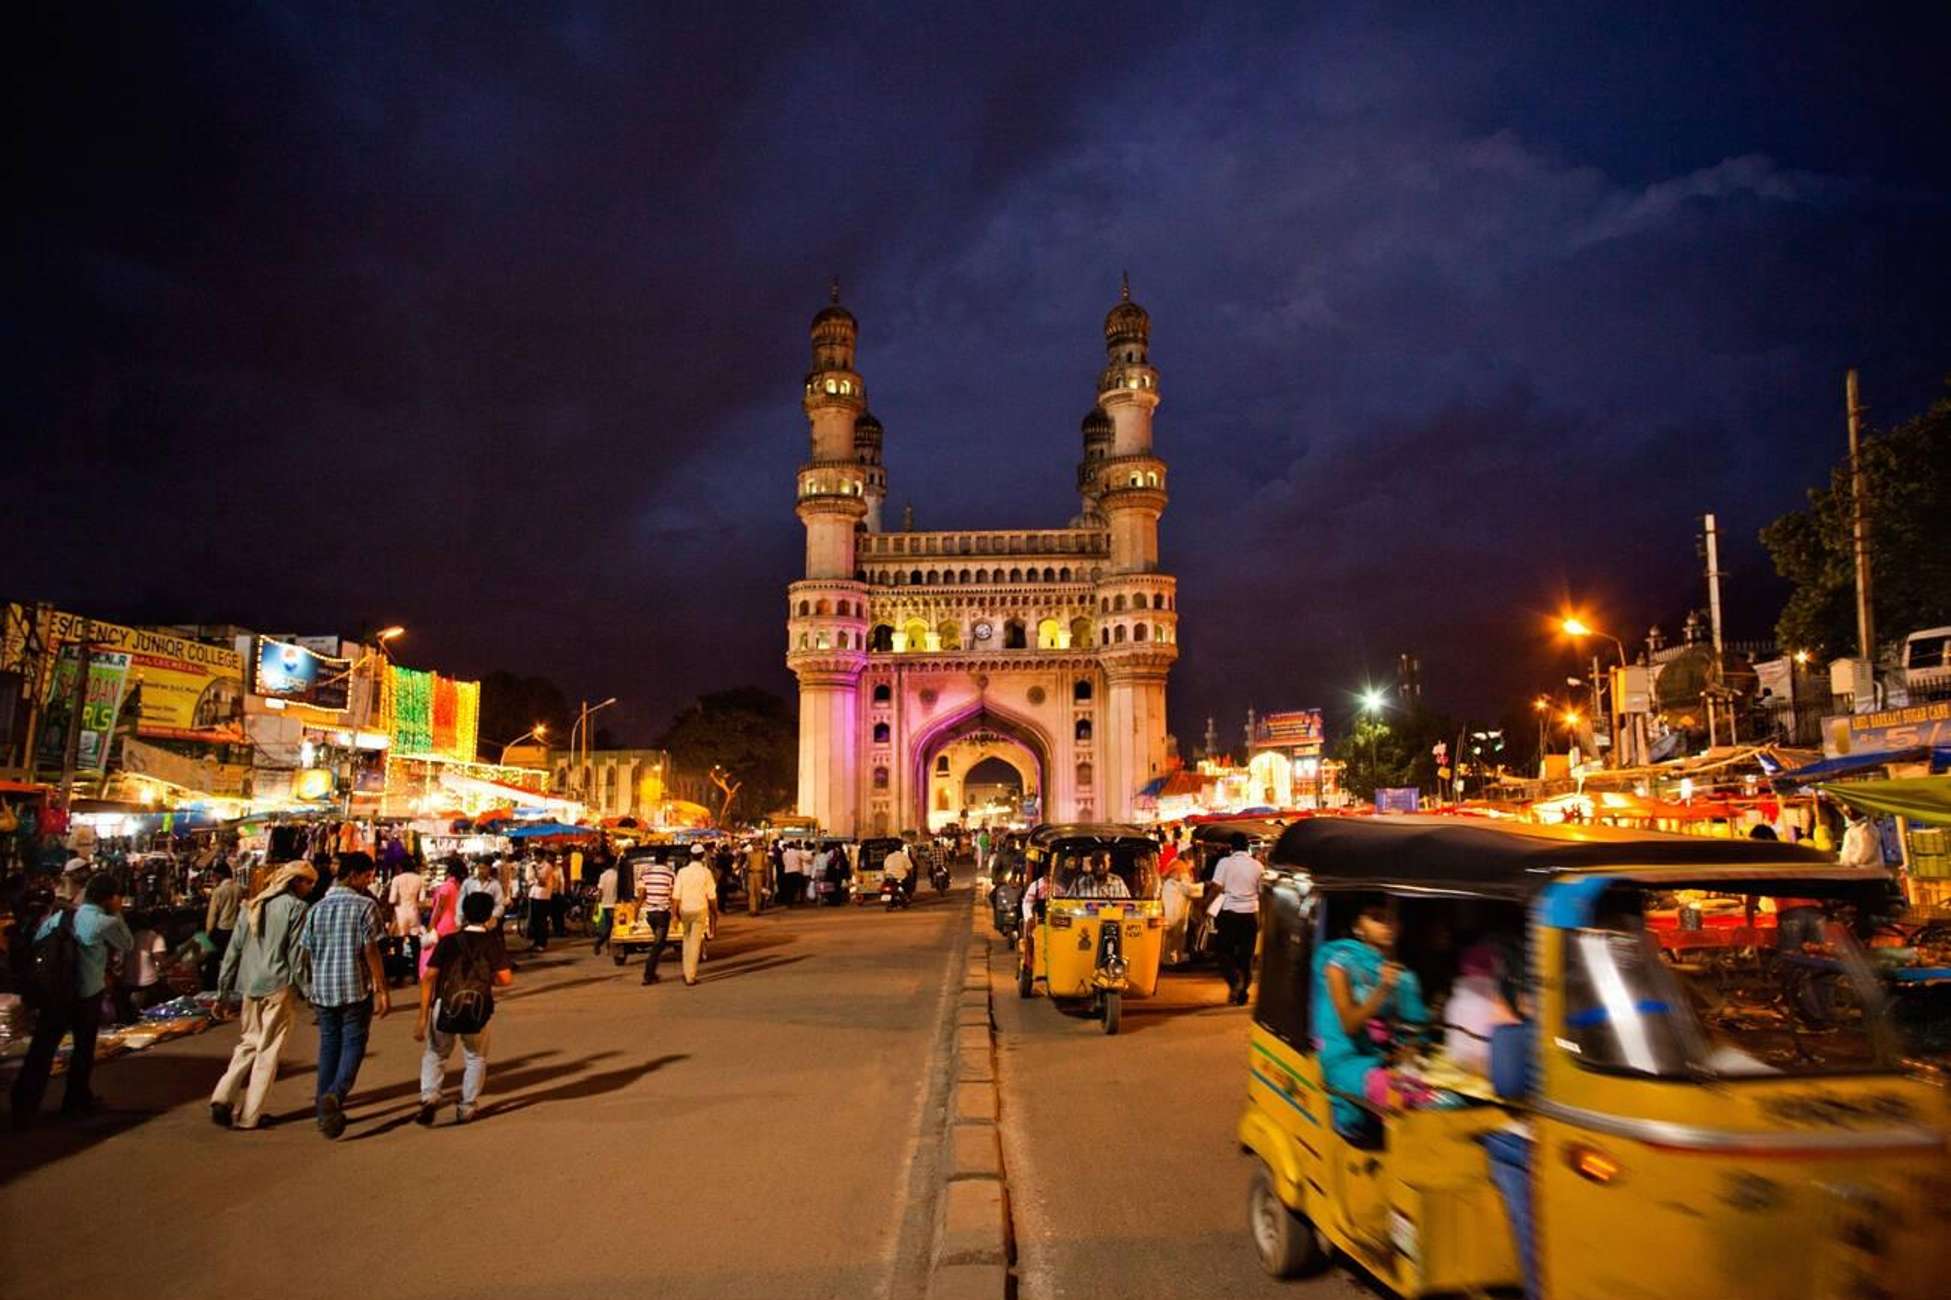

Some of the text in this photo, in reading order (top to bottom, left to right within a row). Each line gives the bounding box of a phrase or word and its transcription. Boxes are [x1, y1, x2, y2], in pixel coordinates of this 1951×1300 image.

[49, 613, 129, 648] ESIDENCY
[132, 632, 184, 658] JUNIOR
[187, 643, 239, 670] COLLEGE
